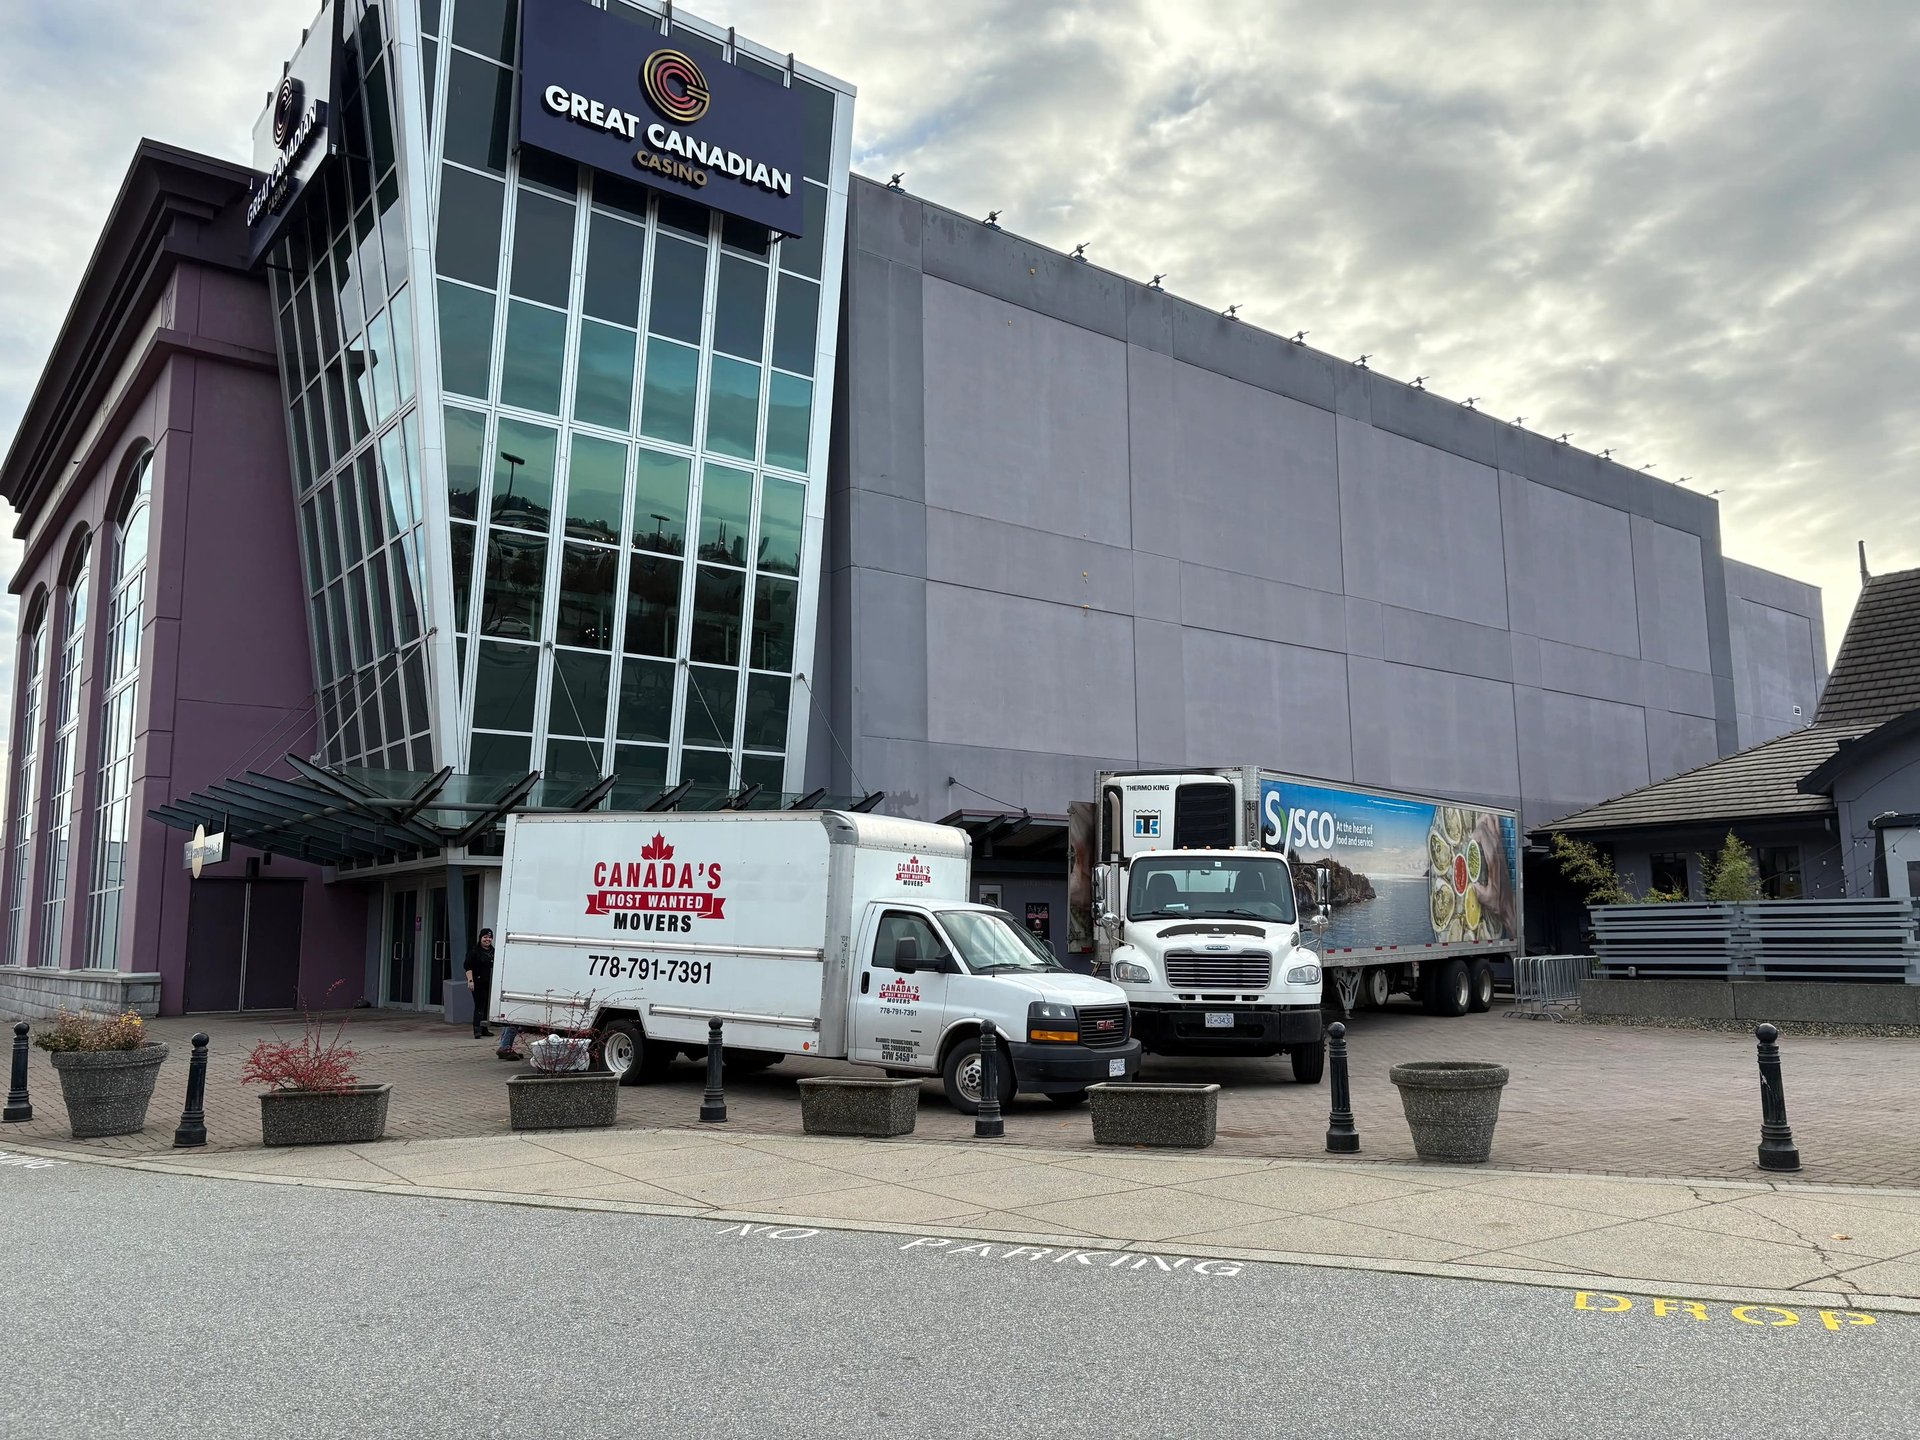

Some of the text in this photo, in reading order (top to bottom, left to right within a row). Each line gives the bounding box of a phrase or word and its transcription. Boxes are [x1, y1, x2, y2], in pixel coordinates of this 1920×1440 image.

[545, 85, 792, 196] GREAT CANADIAN
[247, 99, 317, 226] GREAT CANADIAN
[636, 150, 708, 186] CASINO
[268, 174, 288, 215] CASINO
[1336, 820, 1373, 835] At the heart of
[1336, 834, 1374, 848] food and service
[594, 862, 721, 889] CANADA'S
[897, 863, 930, 874] CANADA'S
[606, 893, 704, 909] MOST WANTED
[613, 912, 692, 932] MOVERS
[588, 955, 712, 984] 778-791-7391
[881, 983, 919, 993] CANADA'S
[880, 1007, 917, 1016] 778-791-7391
[882, 1050, 894, 1060] GVW
[716, 1222, 1246, 1278] NO PARKING
[1573, 1291, 1877, 1331] DROP
